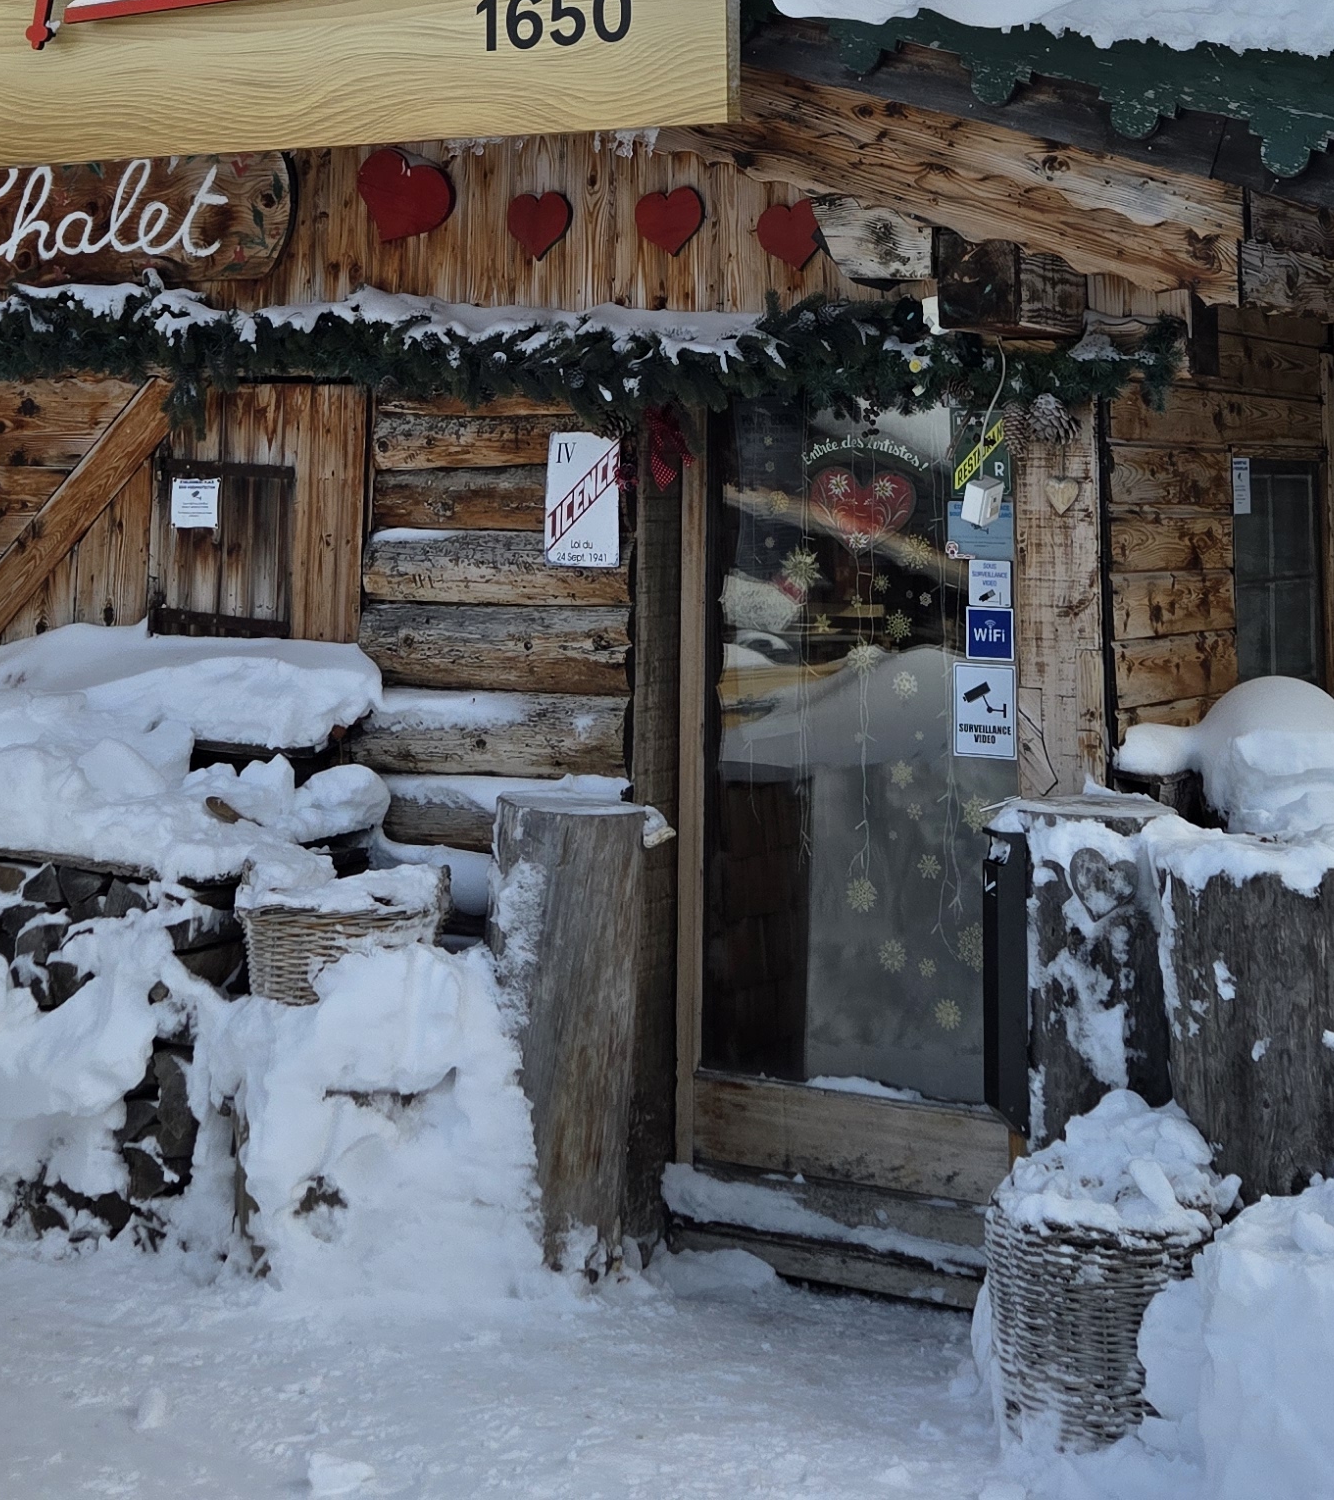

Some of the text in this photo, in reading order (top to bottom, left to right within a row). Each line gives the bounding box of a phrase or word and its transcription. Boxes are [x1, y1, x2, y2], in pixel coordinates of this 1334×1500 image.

[556, 442, 577, 464] IV
[800, 437, 840, 466] Entrée
[994, 461, 1006, 477] R
[548, 442, 621, 551] LICENCE
[570, 539, 593, 550] Loi du
[556, 551, 566, 562] 24
[589, 553, 607, 563] 1941
[971, 570, 1009, 579] SURVEILLANCE
[958, 722, 1012, 736] SURVEILLANCE
[973, 734, 997, 745] VIDEO
